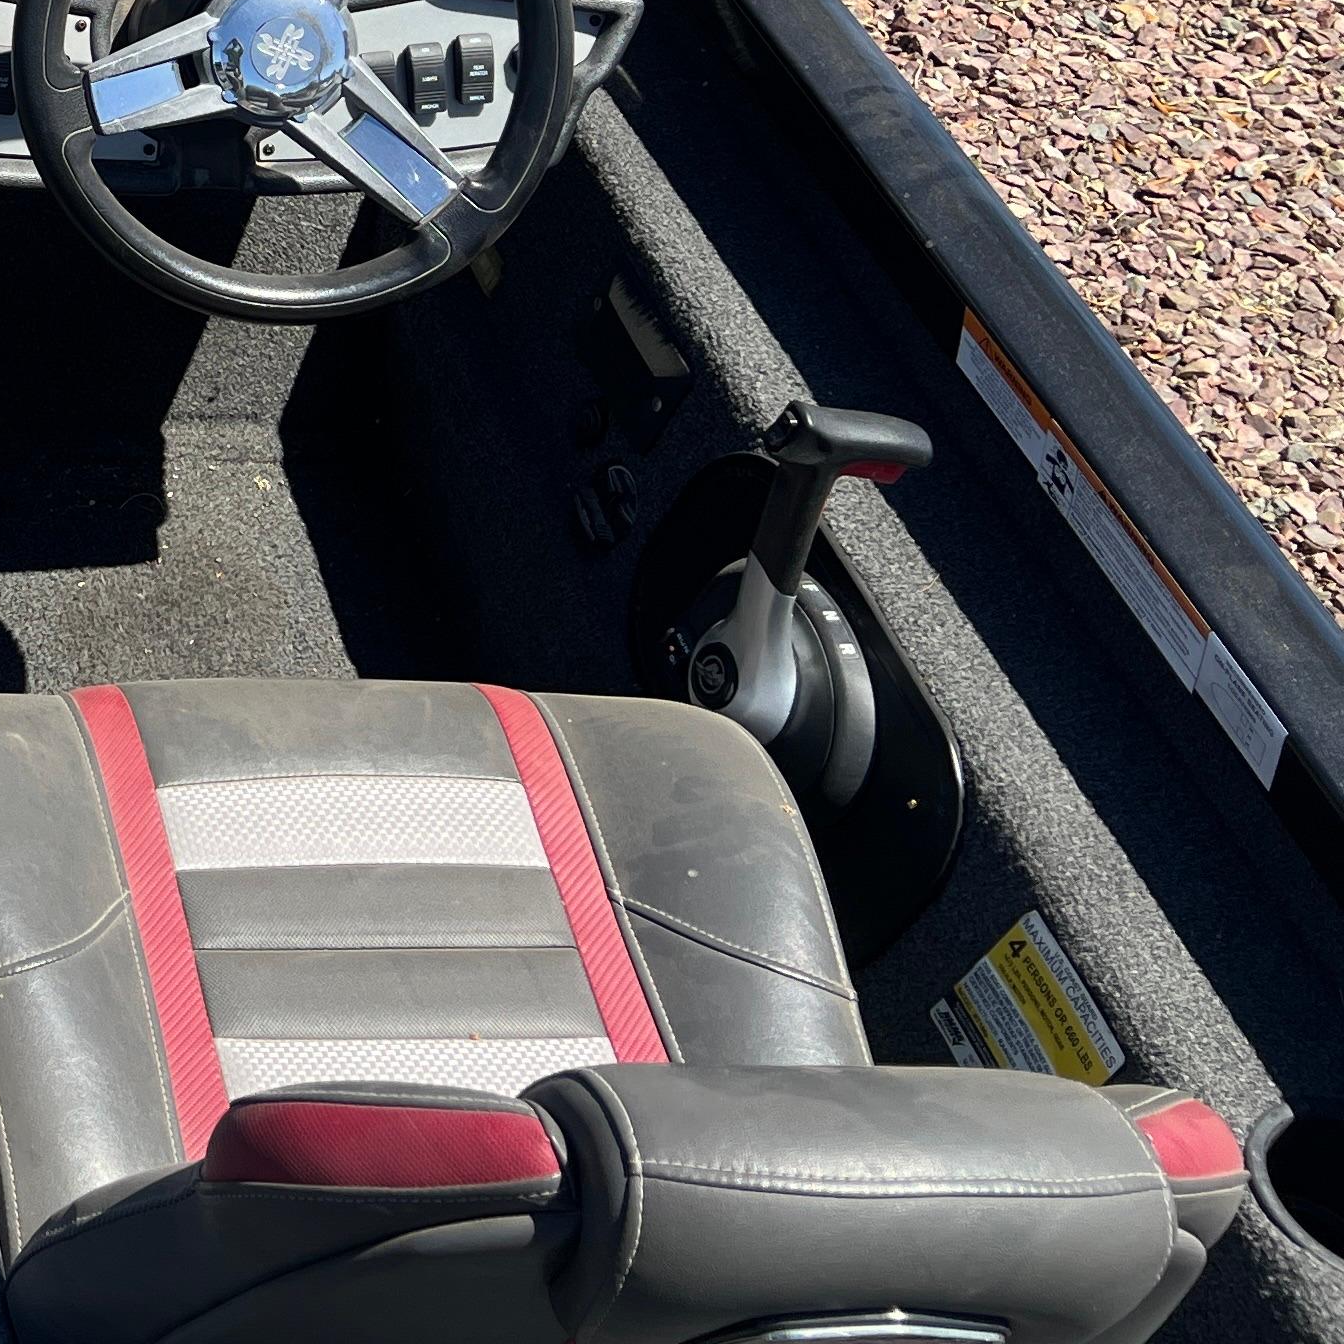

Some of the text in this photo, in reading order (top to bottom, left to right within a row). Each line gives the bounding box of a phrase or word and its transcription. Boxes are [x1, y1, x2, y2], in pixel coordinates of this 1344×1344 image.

[822, 610, 840, 621] N
[838, 643, 857, 655] R
[1008, 940, 1027, 959] 4
[1023, 957, 1057, 1006] PERSONS
[1055, 1007, 1068, 1026] OR
[1076, 1046, 1093, 1073] LBS.
[1023, 917, 1117, 1069] MAXIMUM CAPACITIES
